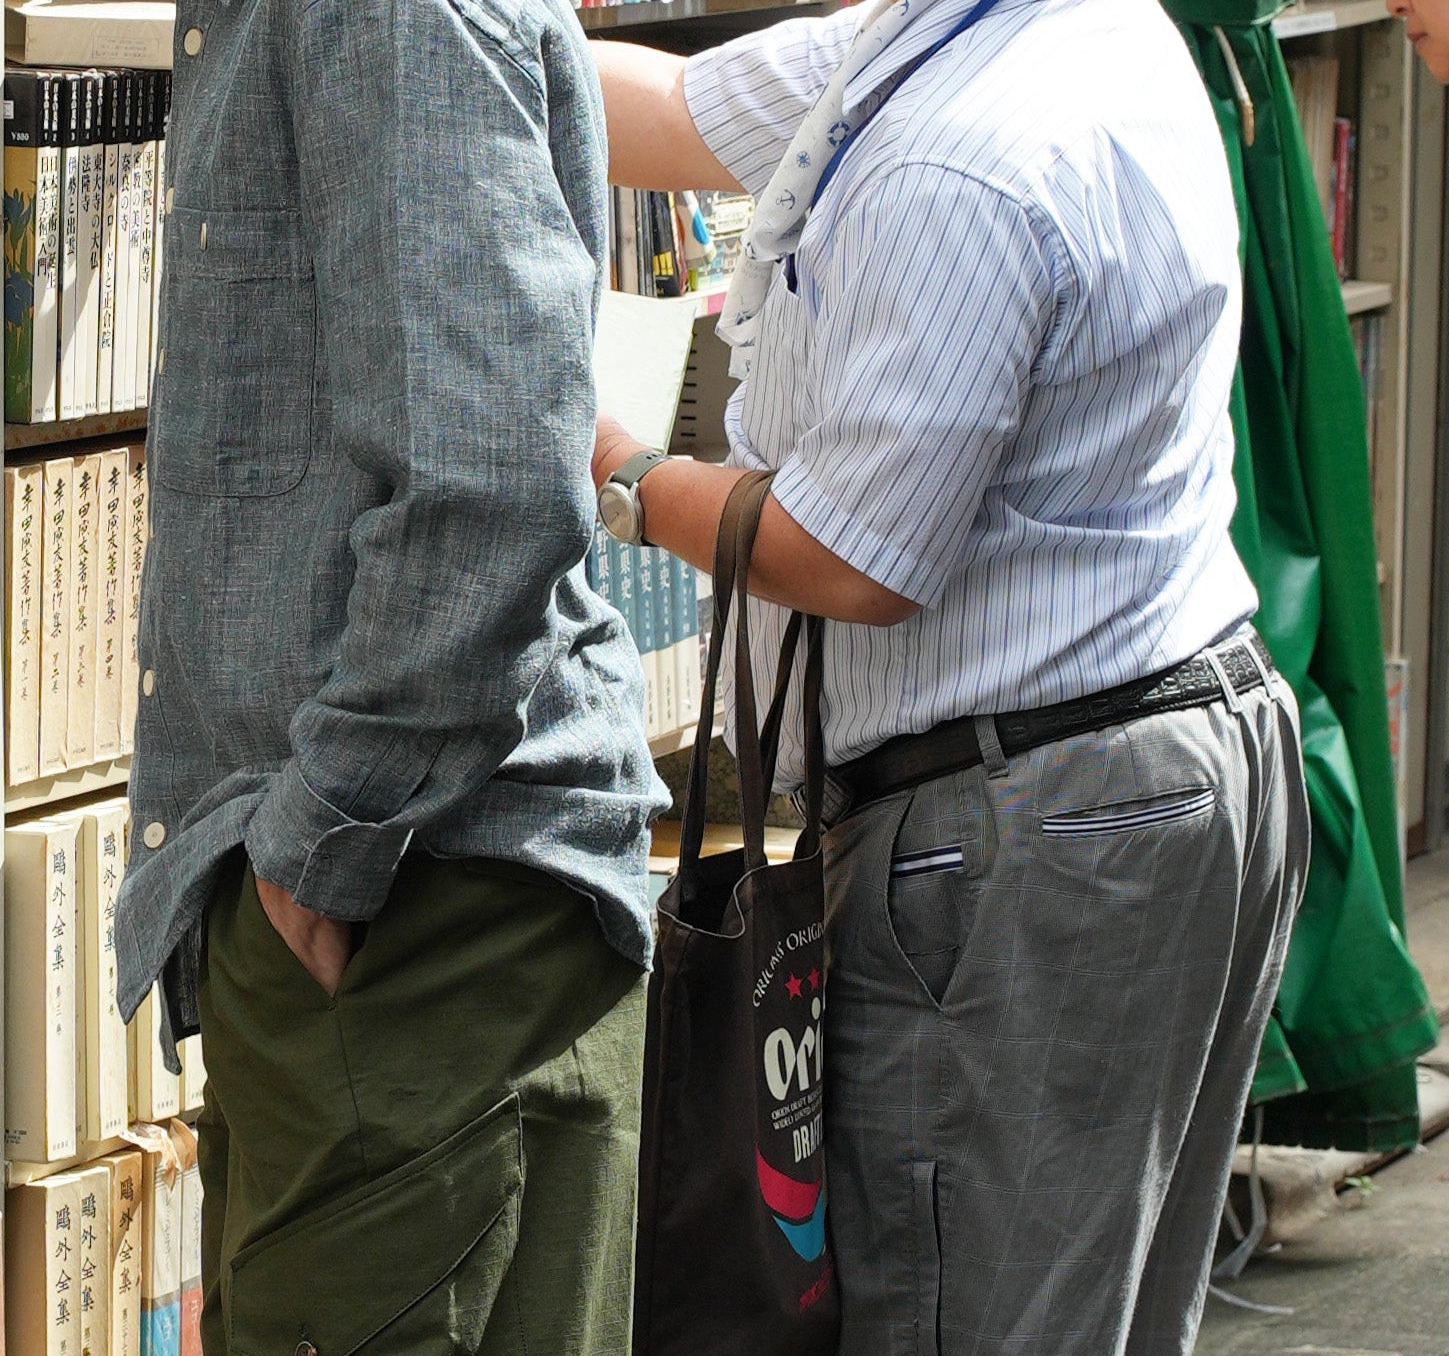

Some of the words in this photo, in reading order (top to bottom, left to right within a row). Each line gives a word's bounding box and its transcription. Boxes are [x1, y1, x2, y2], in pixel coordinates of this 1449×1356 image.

[90, 152, 103, 271] 東大寺の大仏
[763, 995, 824, 1103] Ori
